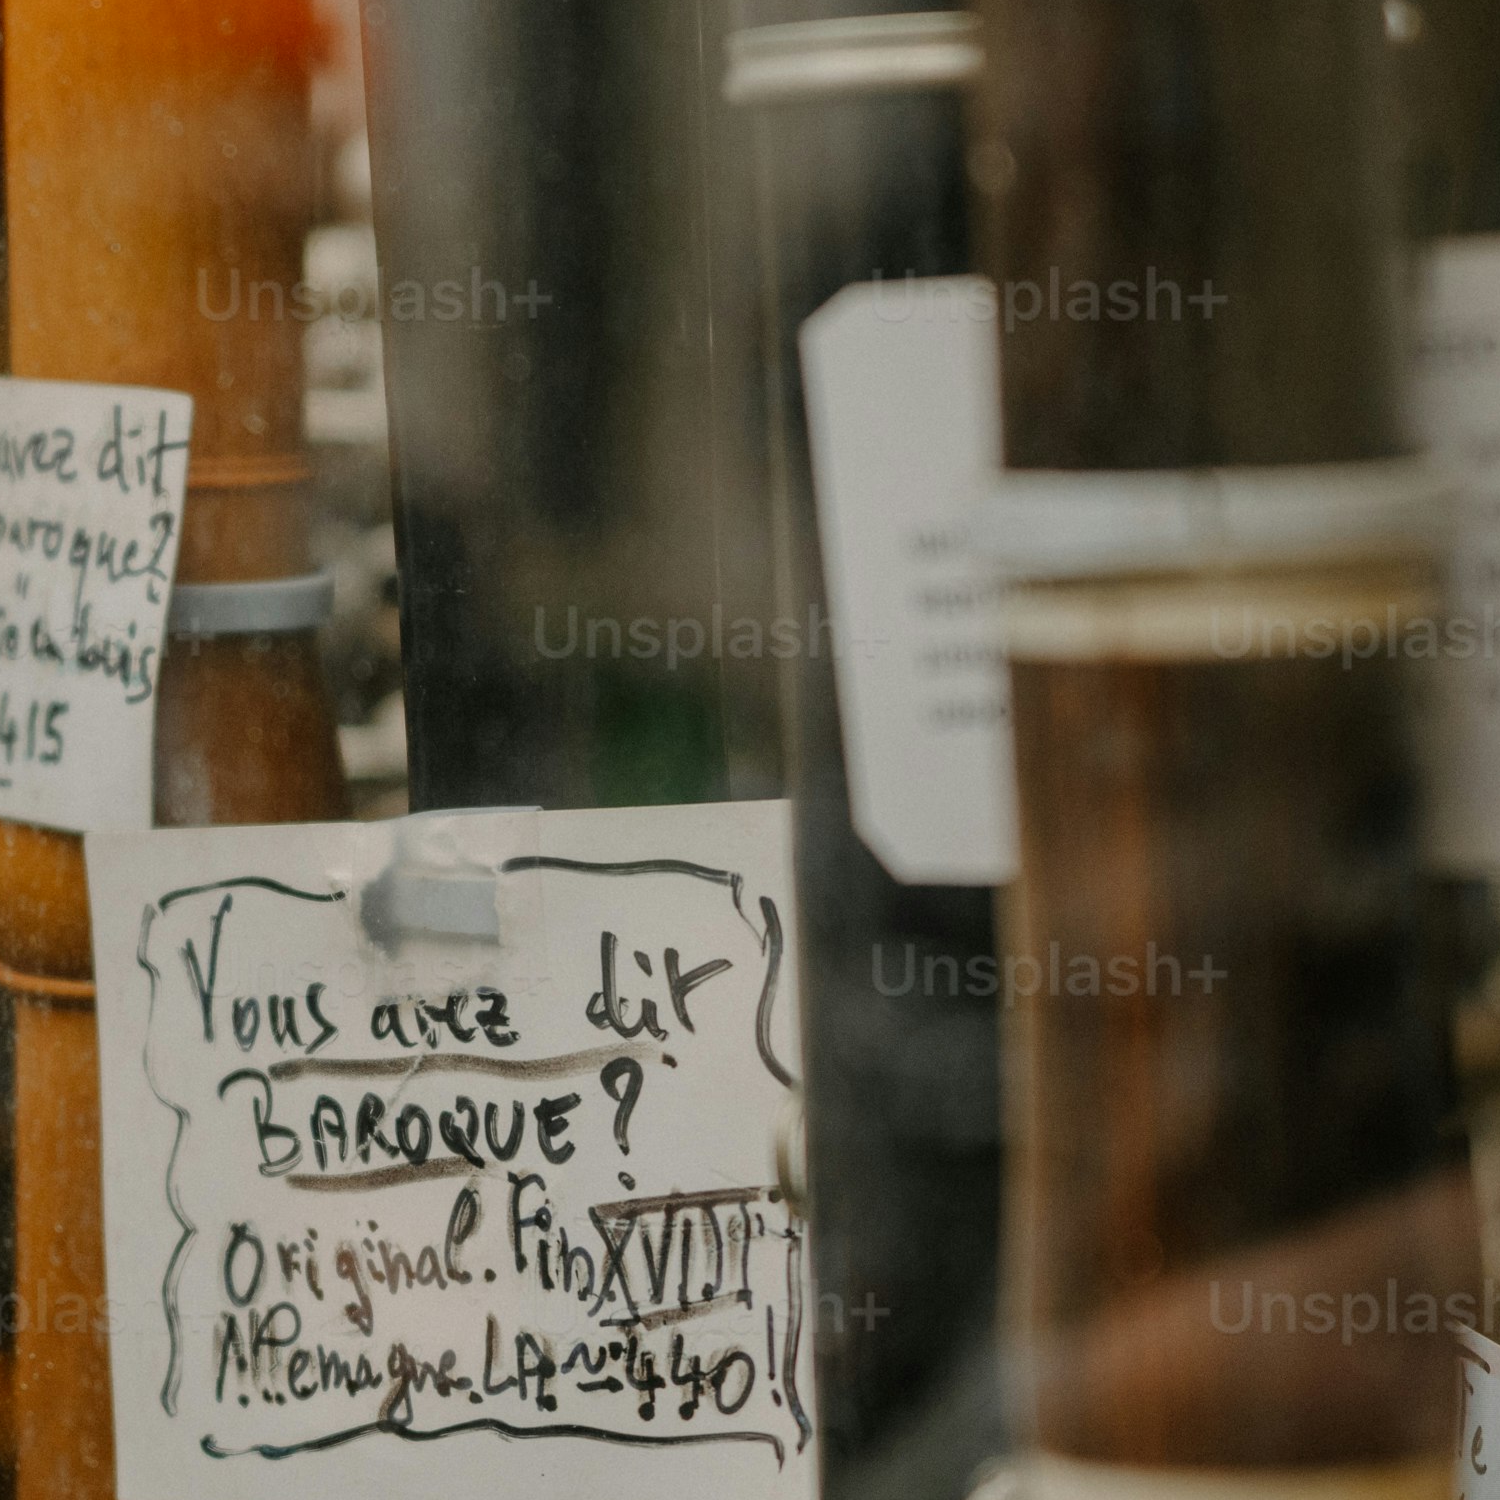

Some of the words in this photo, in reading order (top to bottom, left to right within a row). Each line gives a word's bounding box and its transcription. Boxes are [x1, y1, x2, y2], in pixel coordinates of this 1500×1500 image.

[96, 404, 190, 497] dit
[182, 893, 339, 1054] Vous
[370, 984, 521, 1049] avez
[585, 930, 734, 1042] dit
